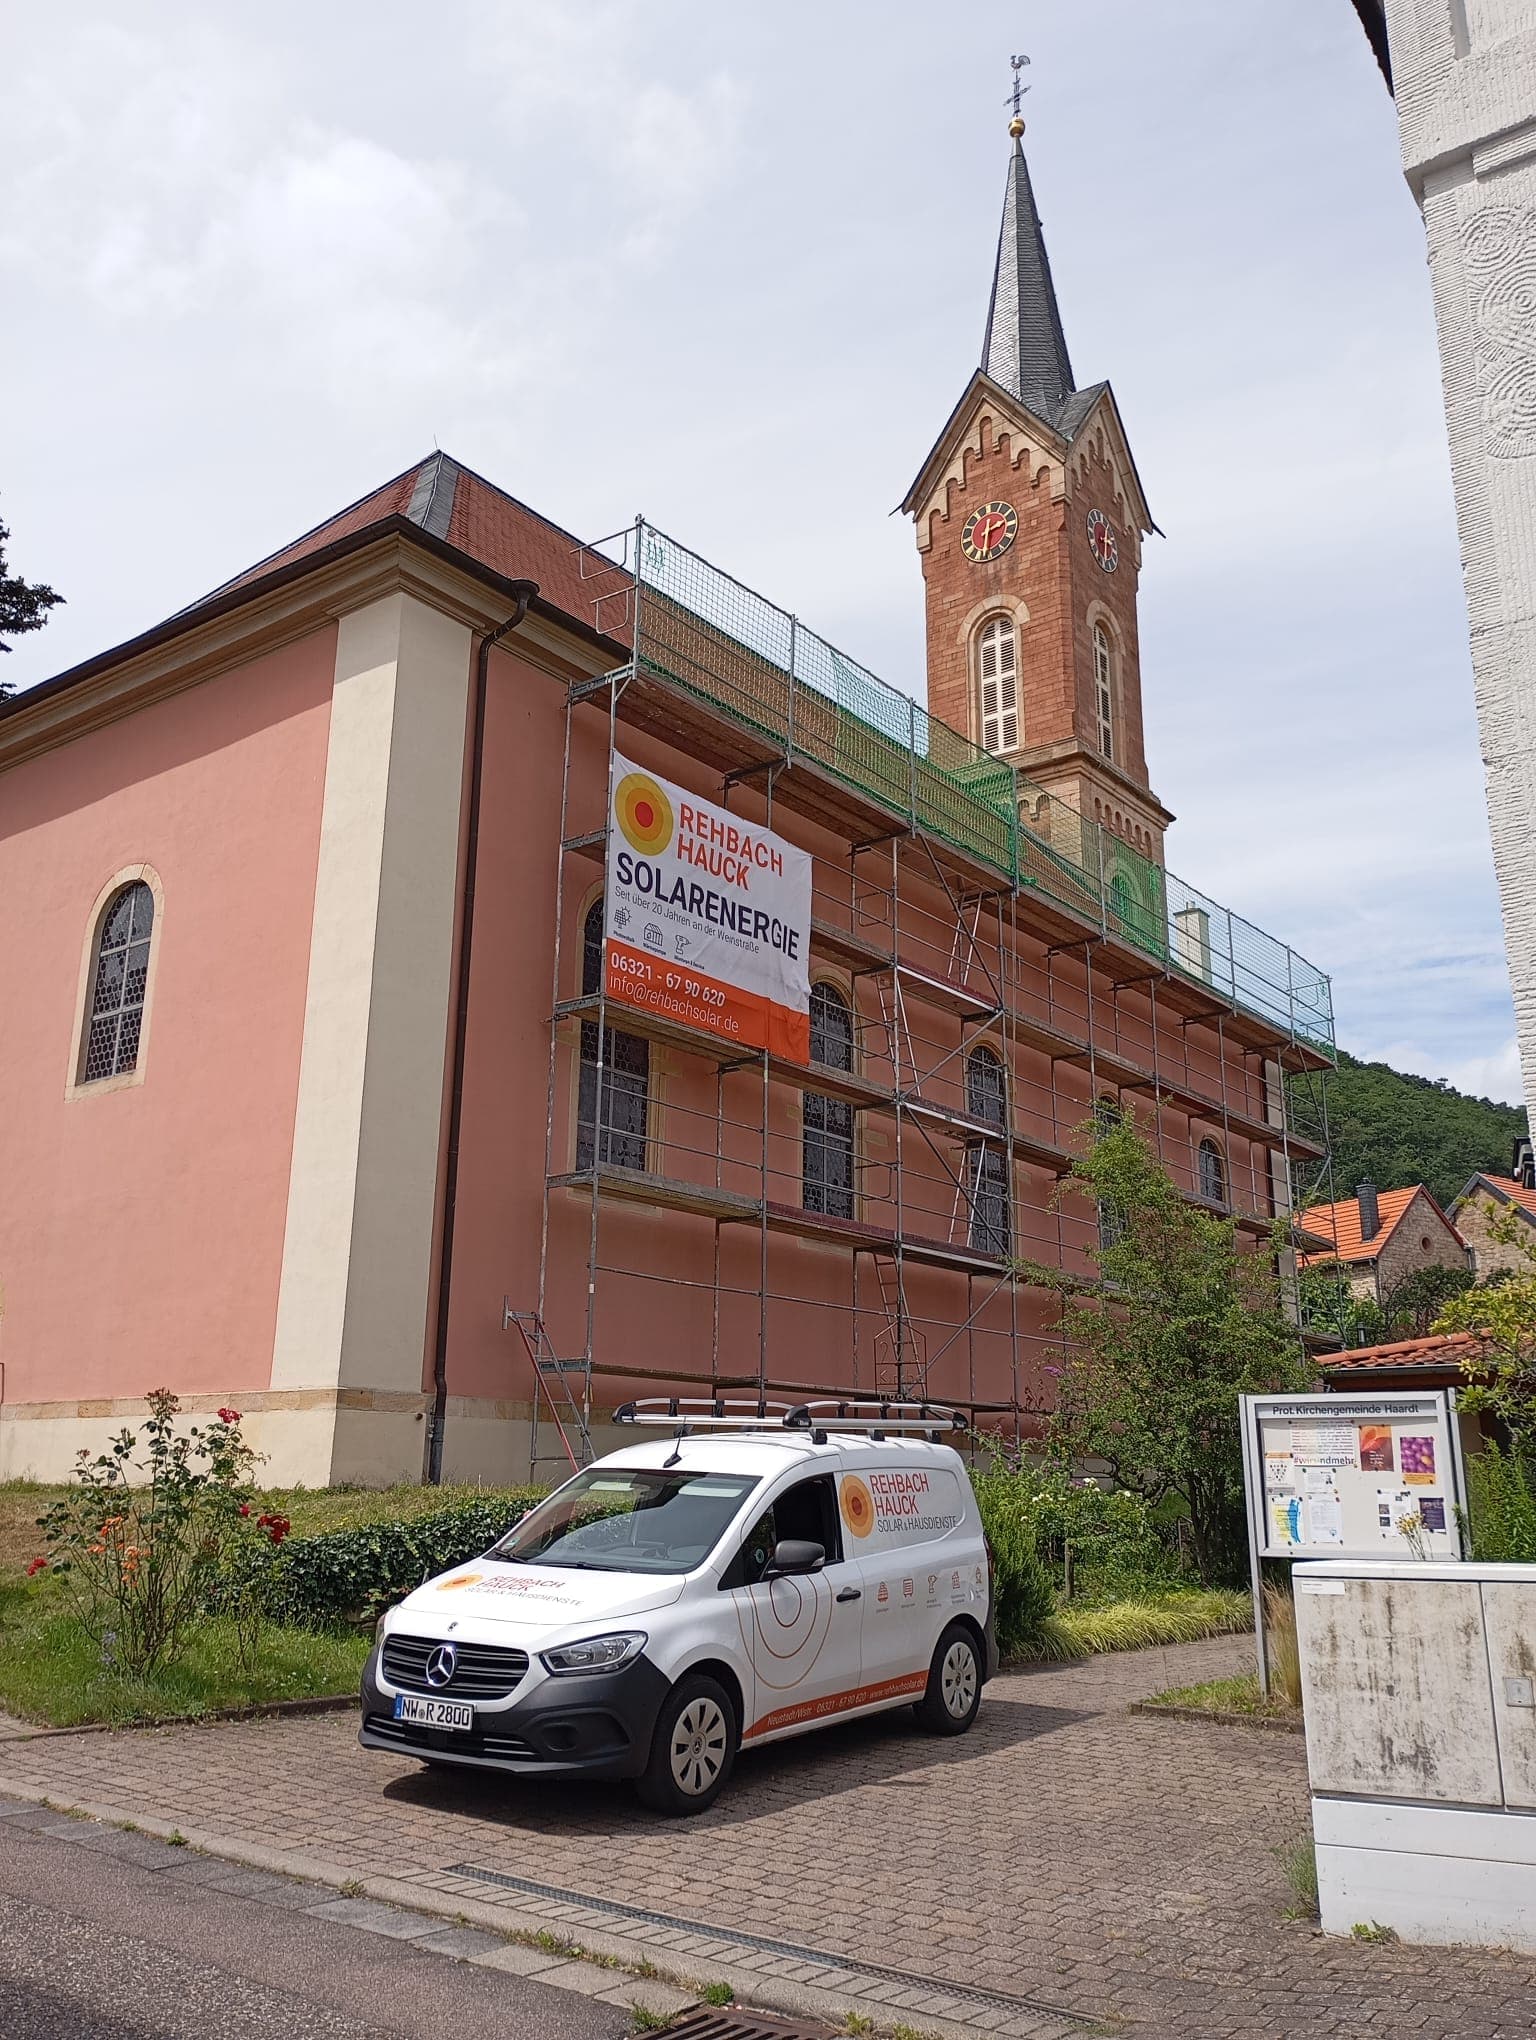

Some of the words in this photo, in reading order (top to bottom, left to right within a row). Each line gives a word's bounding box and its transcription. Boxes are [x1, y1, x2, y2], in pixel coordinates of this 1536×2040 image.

[677, 833, 751, 891] HAUCK
[680, 803, 783, 876] REHBACH
[615, 885, 630, 902] Seit
[632, 893, 651, 909] über
[652, 902, 663, 916] 20
[663, 907, 691, 927] Jahren
[692, 919, 703, 931] an
[704, 922, 716, 937] der
[717, 929, 760, 954] Weinstraße
[616, 852, 800, 960] SOLARENERGIE
[610, 972, 739, 1033] info@rehbachsolar.de
[611, 952, 652, 981] 06321
[666, 972, 681, 990] 67
[685, 979, 700, 998] 90
[702, 987, 726, 1007] 620
[1272, 1406, 1294, 1415] Prot.
[1296, 1404, 1381, 1416] Kirchengemeinde
[1384, 1404, 1419, 1414] Haardt
[869, 1472, 930, 1495] REHBACH
[874, 1495, 919, 1517] HAUCK
[877, 1518, 904, 1533] SOLAR
[907, 1516, 957, 1531] HAUSDIENSTE
[402, 1699, 419, 1718] NW
[425, 1702, 435, 1721] R
[436, 1704, 470, 1726] 2800
